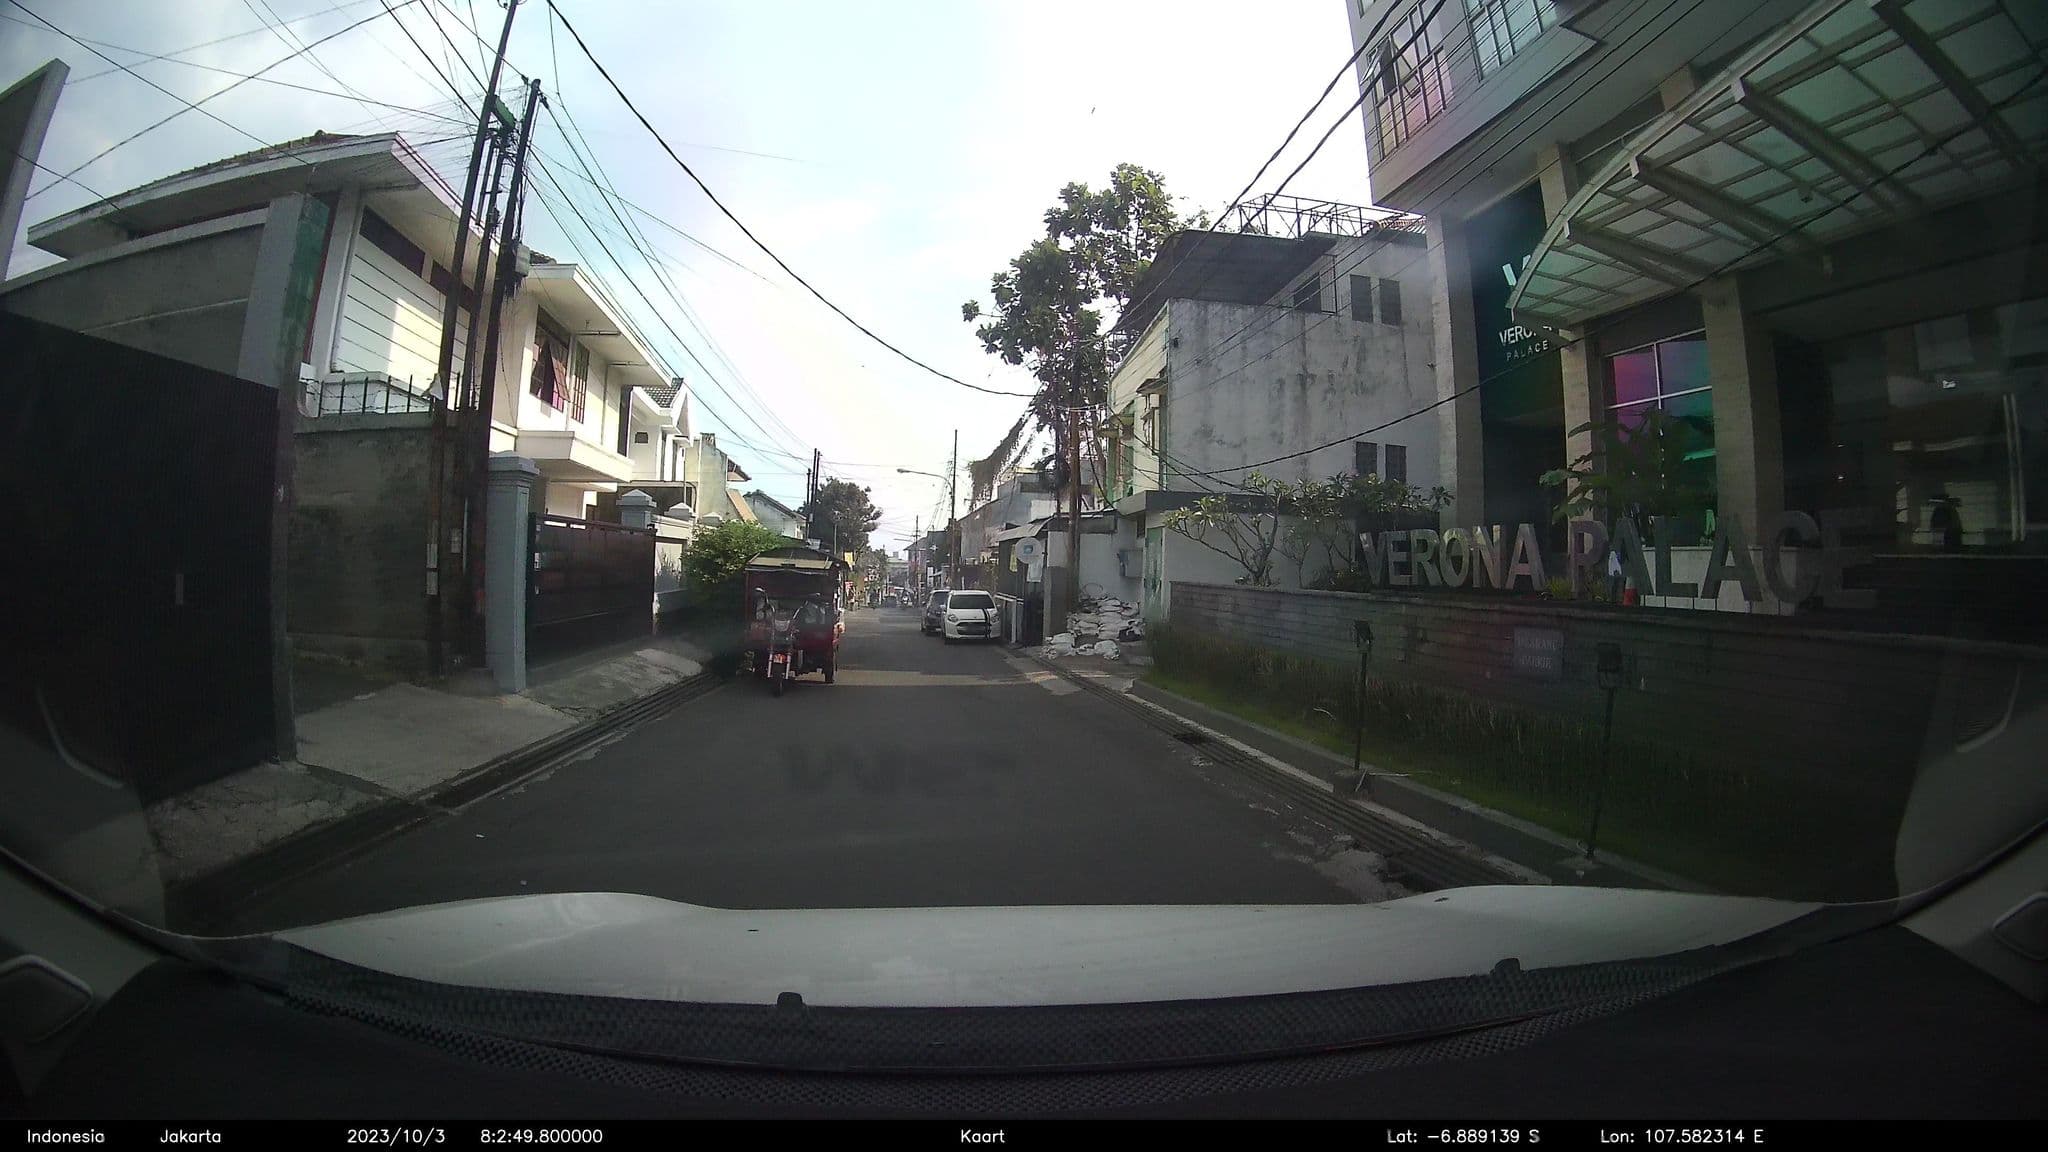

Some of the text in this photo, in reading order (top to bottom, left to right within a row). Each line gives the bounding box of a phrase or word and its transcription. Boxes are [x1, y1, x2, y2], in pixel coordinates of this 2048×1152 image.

[1506, 340, 1549, 361] PALACE
[1359, 507, 1880, 609] VERONA PALACE
